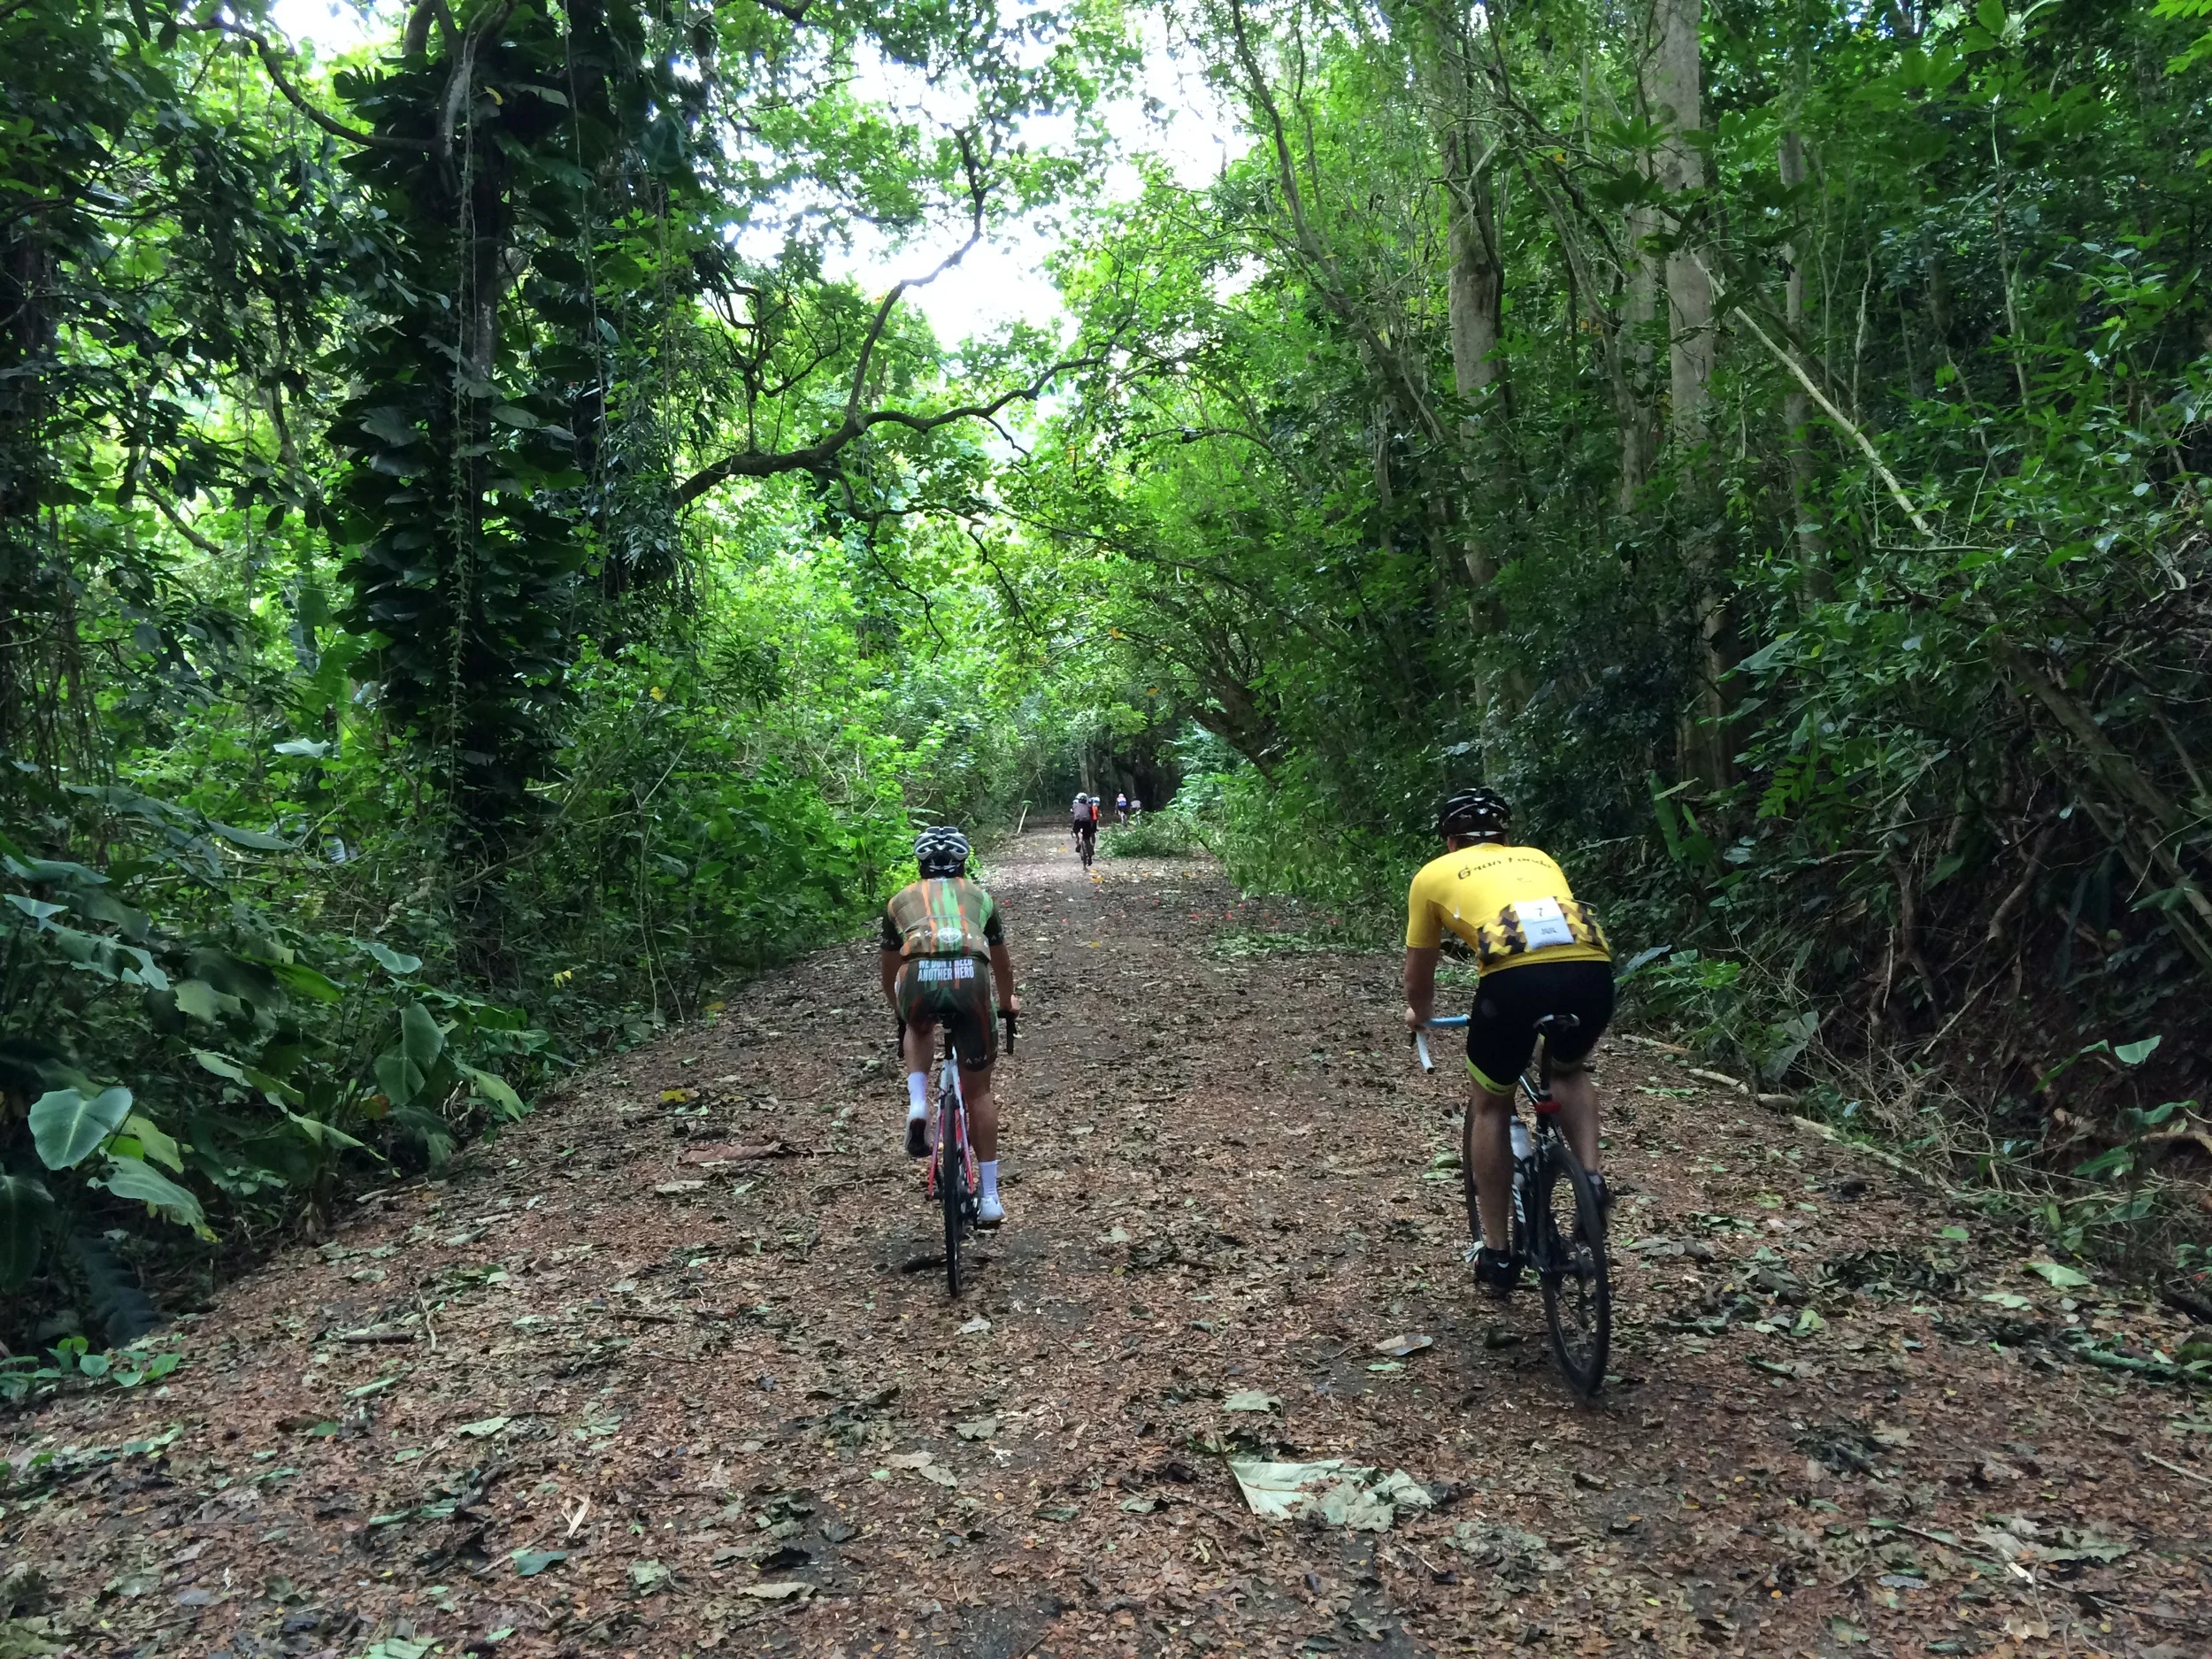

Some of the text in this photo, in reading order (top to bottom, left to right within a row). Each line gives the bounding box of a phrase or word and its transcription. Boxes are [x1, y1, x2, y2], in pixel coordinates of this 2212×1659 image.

[1458, 860, 1502, 879] Gran
[918, 966, 974, 981] ANOTHER HERO
